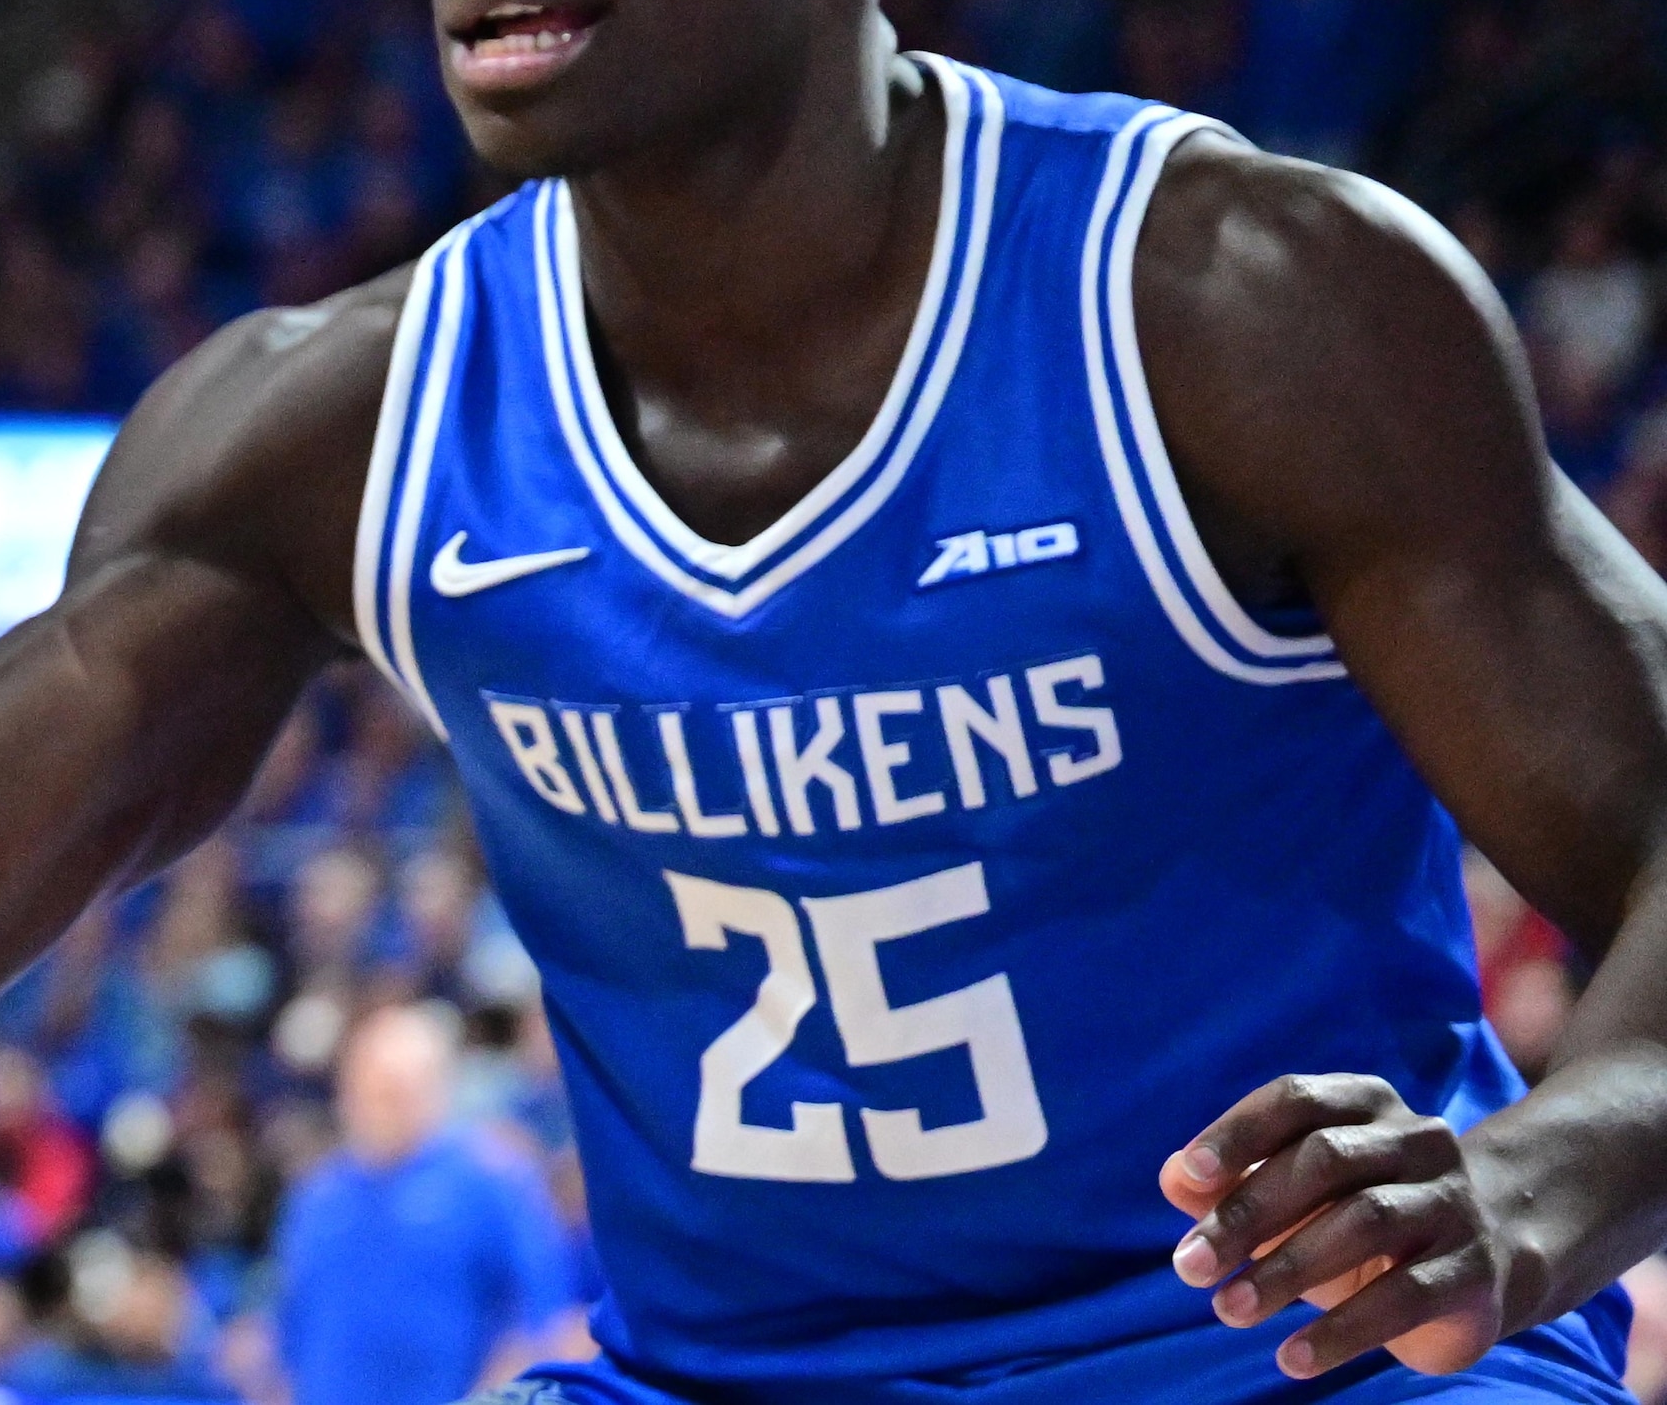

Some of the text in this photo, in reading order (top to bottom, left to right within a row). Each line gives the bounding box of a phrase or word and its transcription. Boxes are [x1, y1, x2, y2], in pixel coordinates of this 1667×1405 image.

[917, 522, 1079, 588] A10
[485, 652, 1124, 838] BILLIKENS
[663, 861, 1049, 1183] 25
